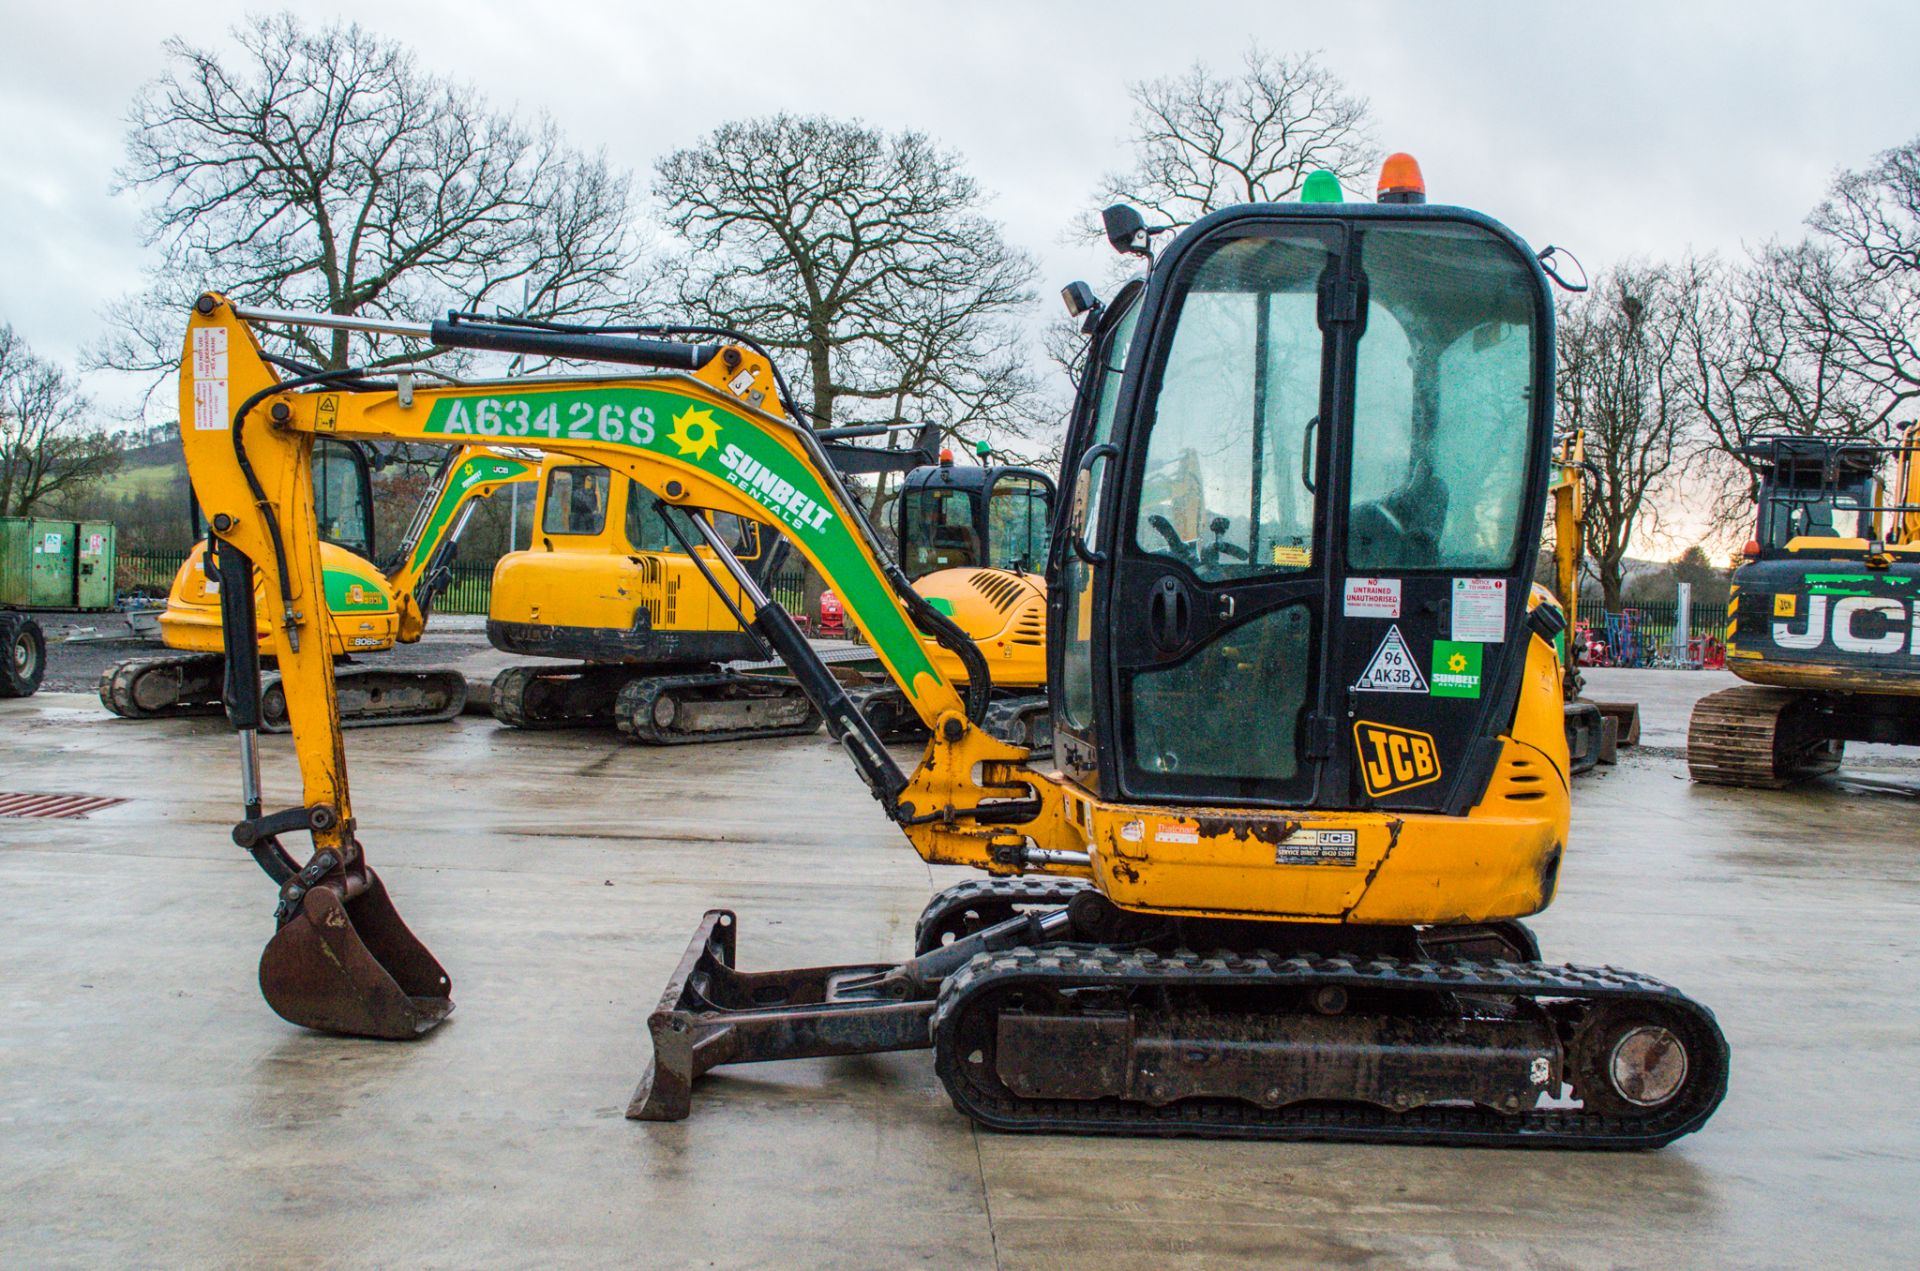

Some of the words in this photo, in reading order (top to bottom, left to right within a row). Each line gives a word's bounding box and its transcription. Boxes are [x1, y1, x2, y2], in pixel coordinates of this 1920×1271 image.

[443, 399, 656, 445] A63426S
[718, 442, 832, 529] SUNBELT
[725, 472, 804, 532] RENTALS
[1353, 586, 1392, 594] UNTRAINED
[1346, 594, 1398, 603] UNAUTHORISED
[1772, 595, 1920, 655] JC
[1384, 651, 1402, 665] 96
[1374, 668, 1411, 683] AK3B
[1432, 673, 1479, 684] SUNBELT
[1367, 729, 1434, 789] JCB
[1320, 833, 1352, 843] JCB
